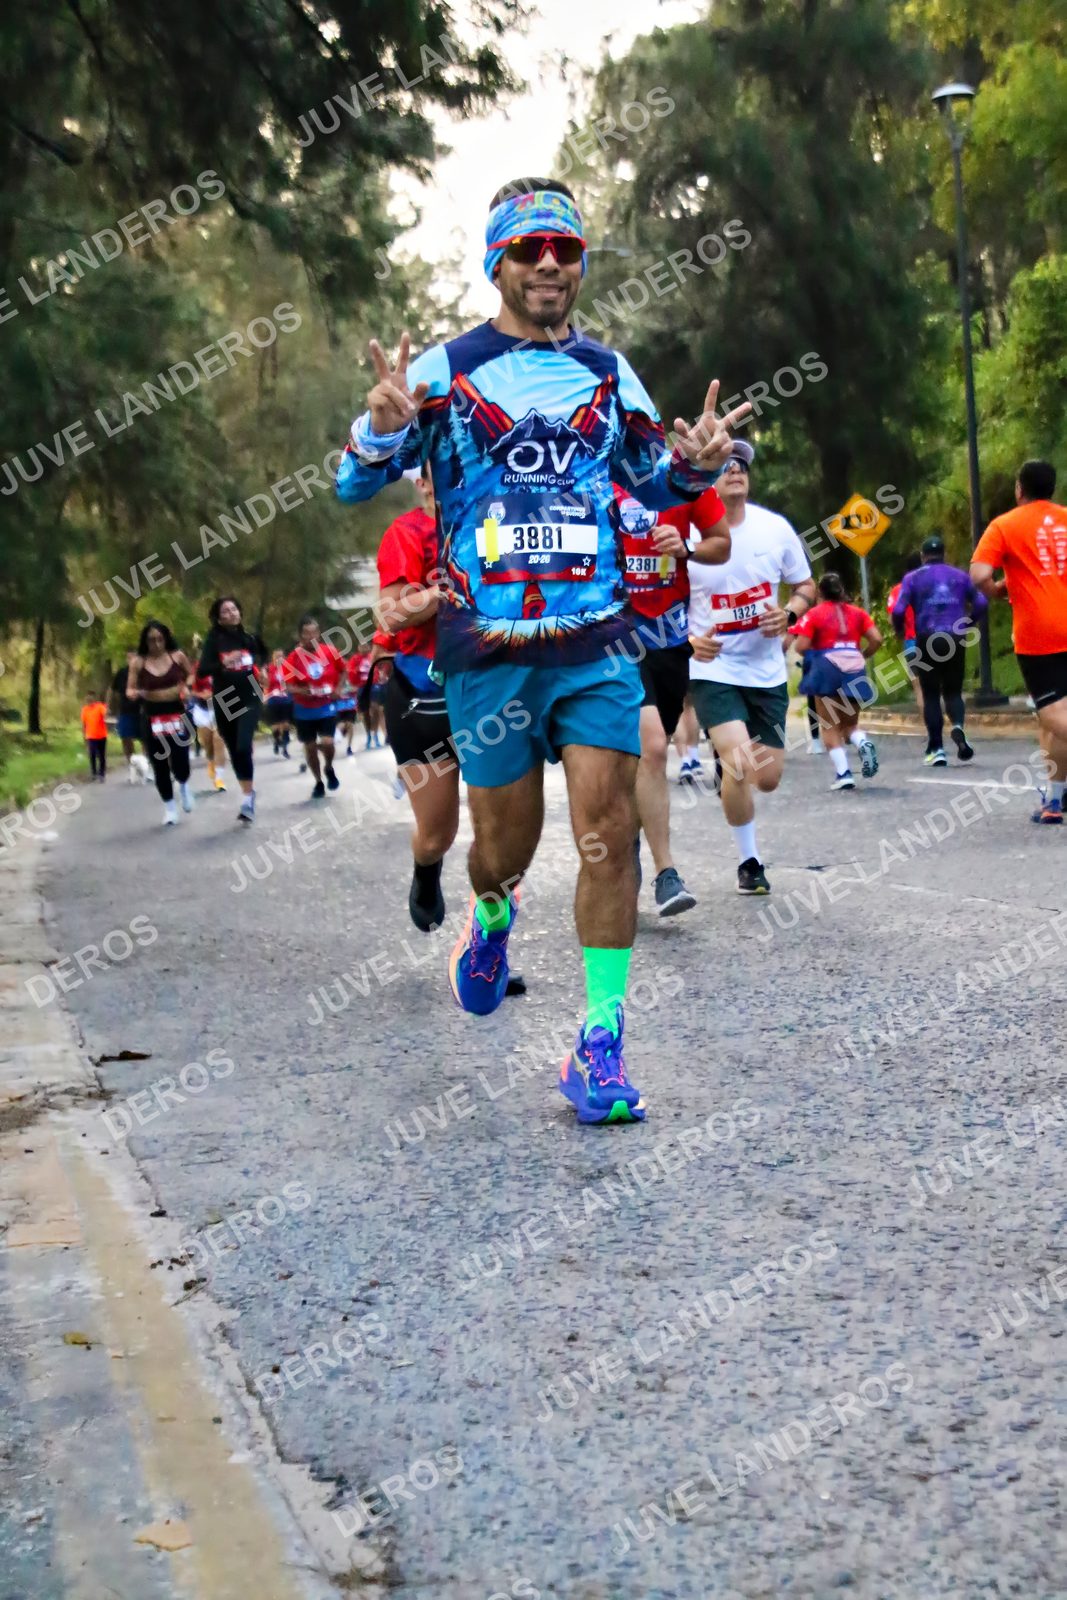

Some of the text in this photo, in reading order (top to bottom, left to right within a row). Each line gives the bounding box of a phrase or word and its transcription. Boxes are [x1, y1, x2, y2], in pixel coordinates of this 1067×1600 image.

[507, 440, 578, 474] OV
[504, 474, 556, 485] RUNNING
[513, 526, 563, 550] 3881
[571, 567, 587, 576] 10K
[627, 557, 657, 572] 2381
[733, 603, 757, 620] 1322
